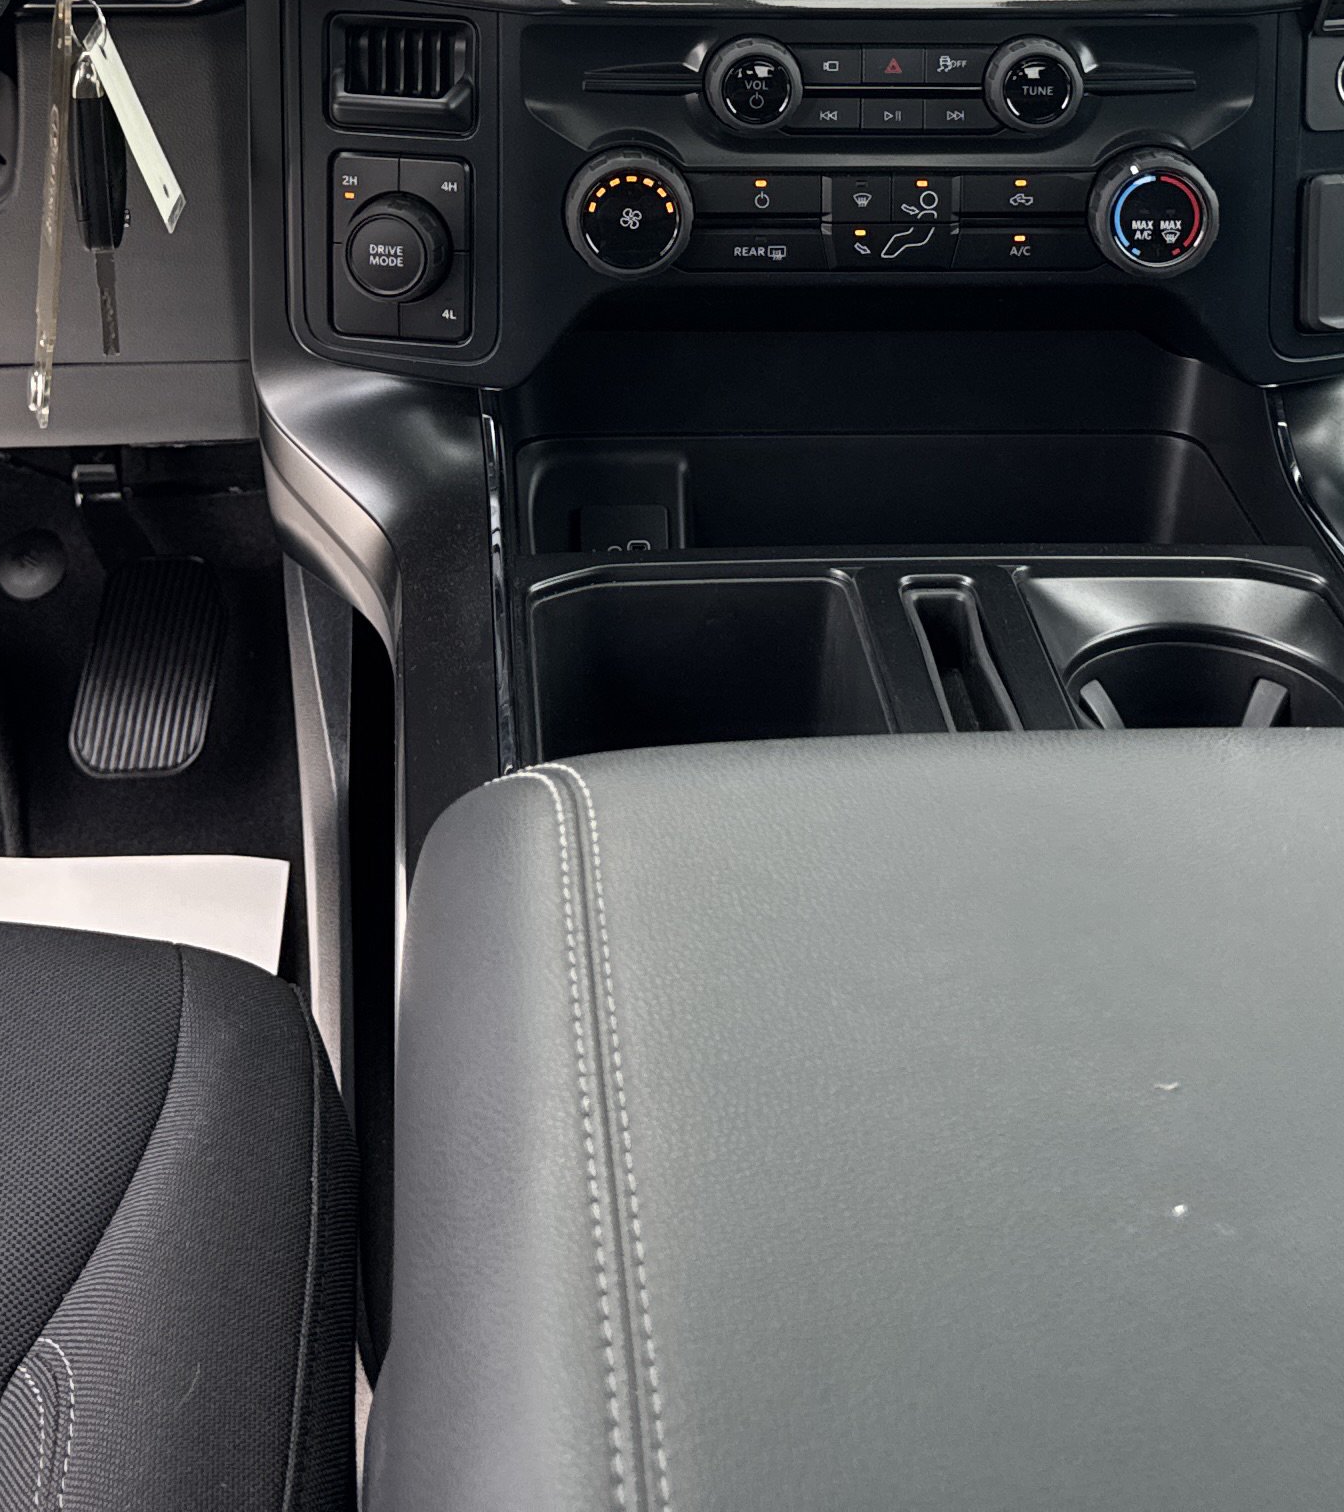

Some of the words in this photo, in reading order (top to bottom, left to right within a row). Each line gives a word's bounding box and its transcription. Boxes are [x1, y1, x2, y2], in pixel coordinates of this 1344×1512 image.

[744, 80, 768, 90] VOL
[1022, 85, 1054, 96] TUNE
[342, 176, 358, 185] 2H
[441, 182, 457, 192] 4H
[1131, 220, 1154, 230] MAX
[1159, 220, 1182, 230] MAX
[1134, 230, 1153, 240] A/C
[369, 245, 403, 256] DRIVE
[733, 246, 766, 257] REAR
[1009, 246, 1031, 256] A/C
[369, 256, 403, 267] MODE
[441, 310, 457, 319] 4L
